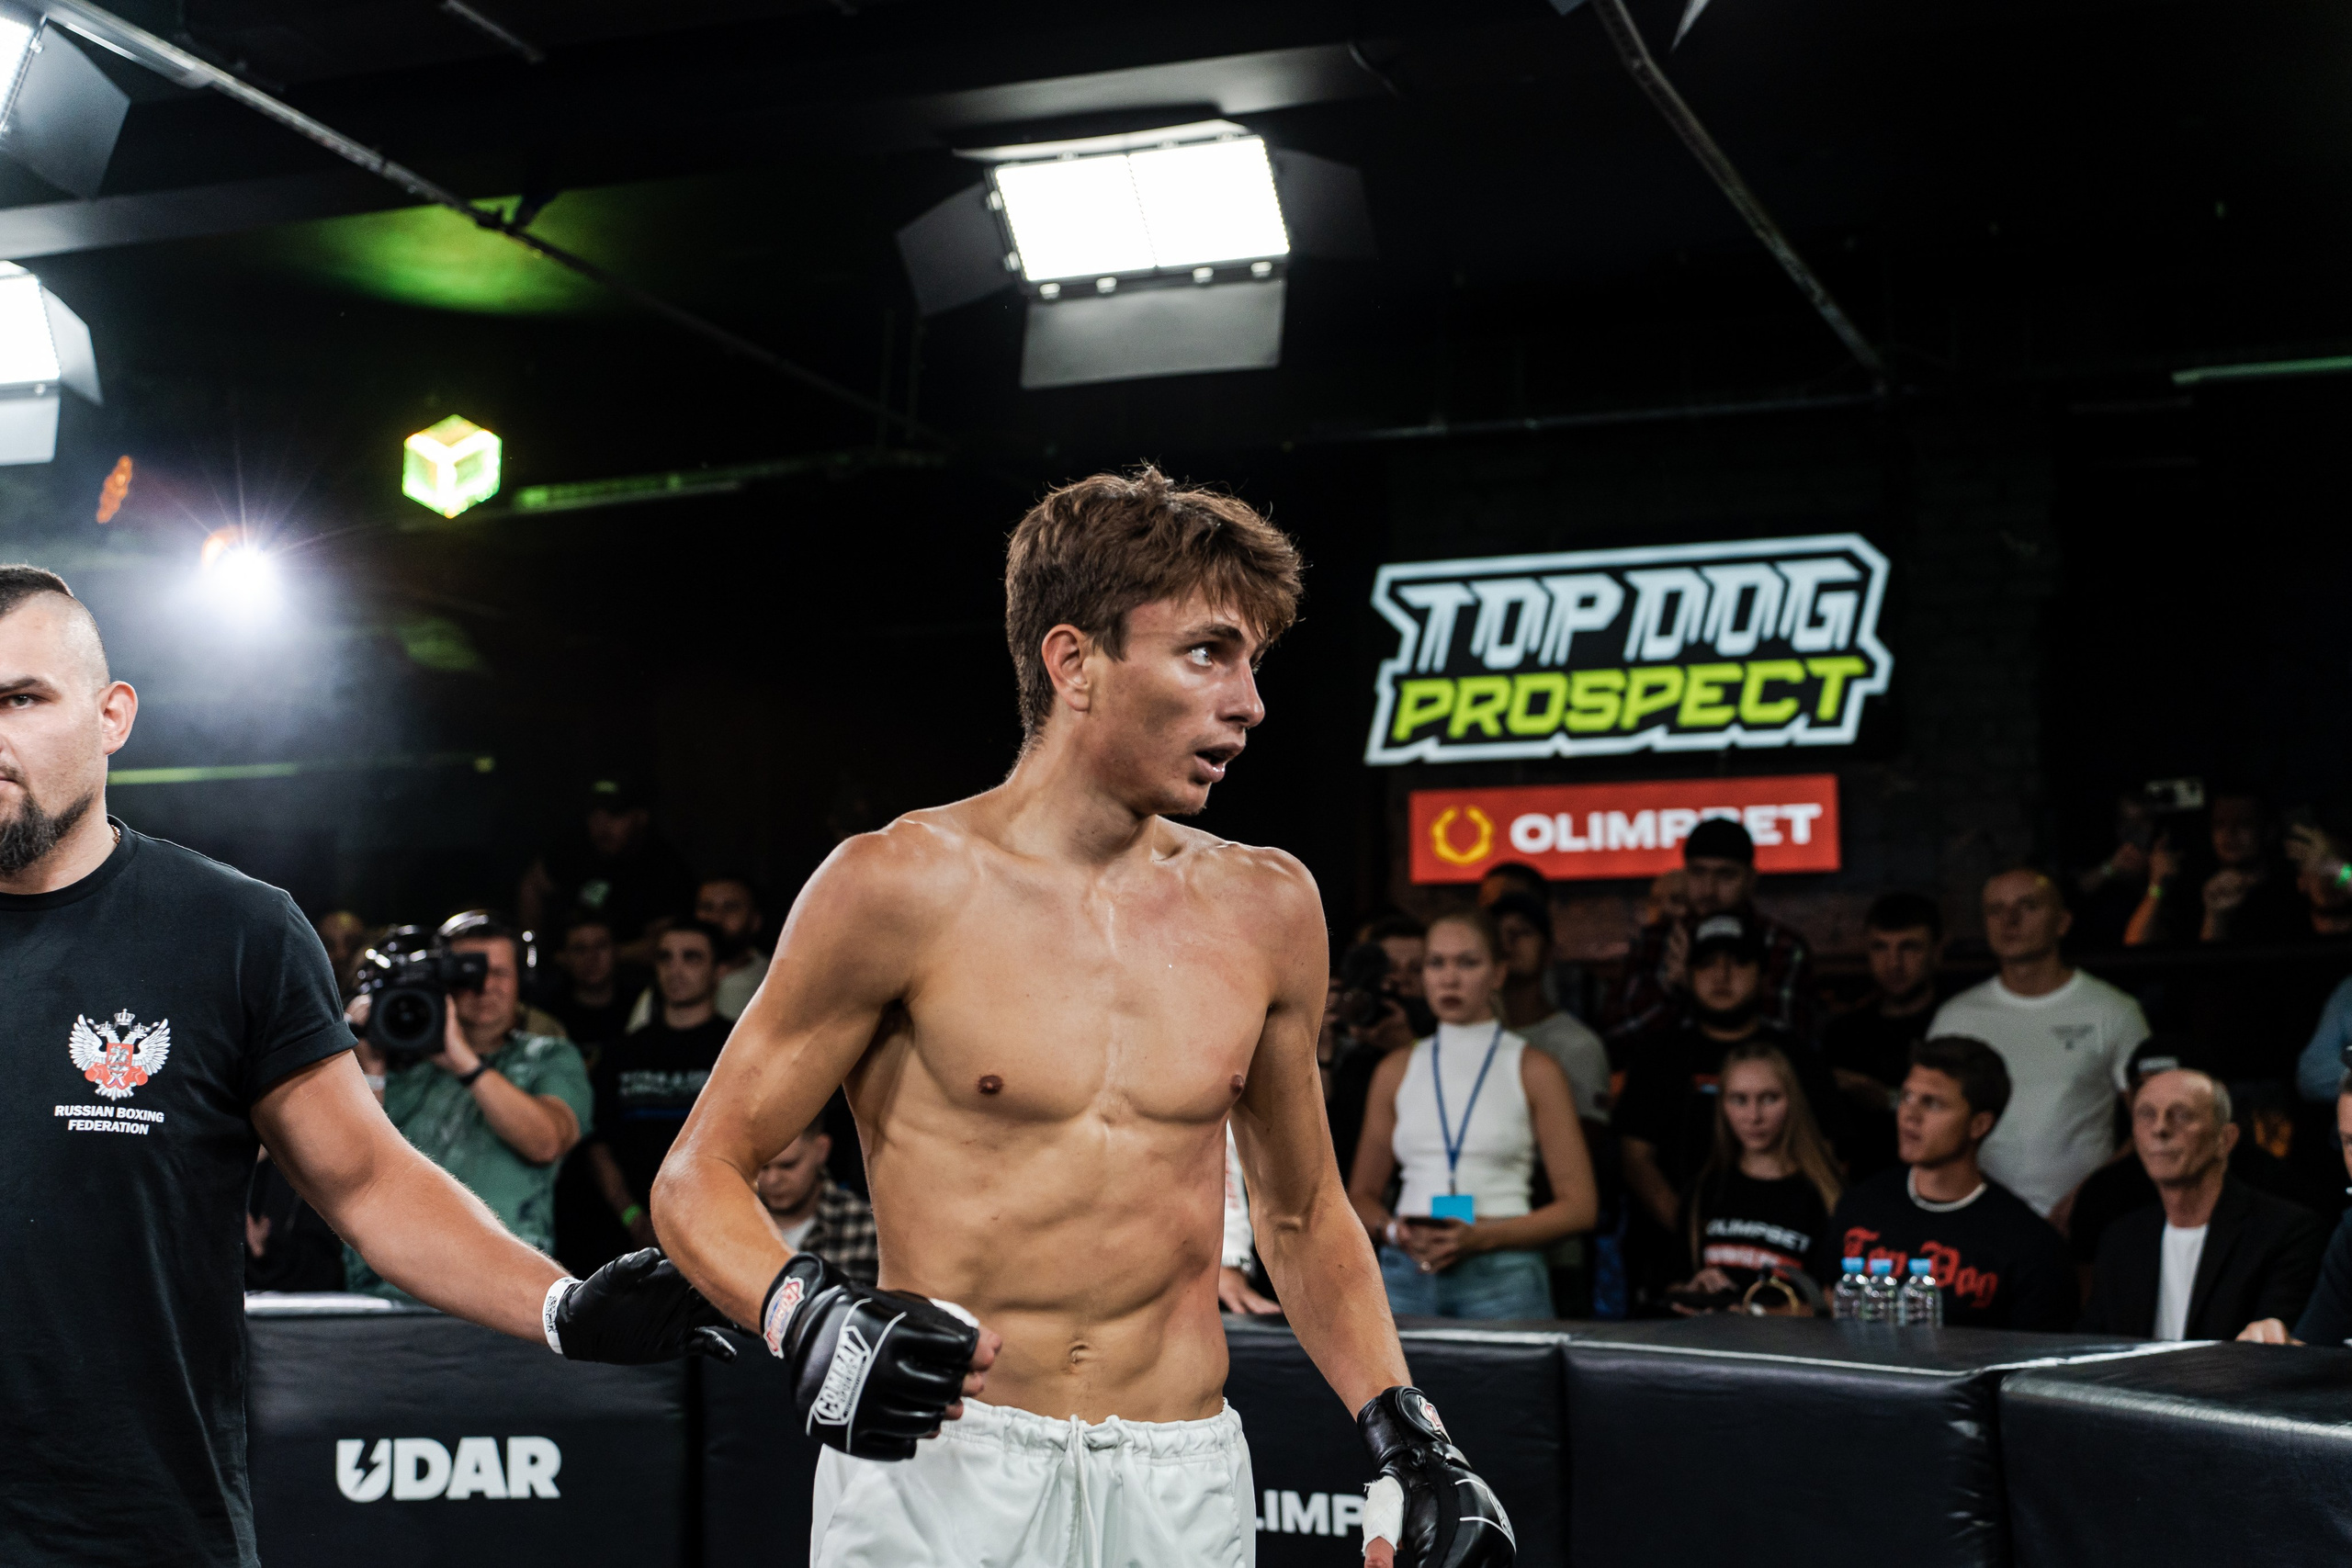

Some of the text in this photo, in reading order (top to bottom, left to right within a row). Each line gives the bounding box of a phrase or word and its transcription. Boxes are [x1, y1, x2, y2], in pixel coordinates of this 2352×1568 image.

[1396, 557, 1863, 673] TOP DOG
[1392, 656, 1867, 741] PROSPECT
[1510, 803, 1823, 854] OLIMPET
[54, 1105, 164, 1122] RUSSIAN BOXING
[68, 1119, 149, 1134] FEDERATION
[335, 1436, 562, 1503] UDAR
